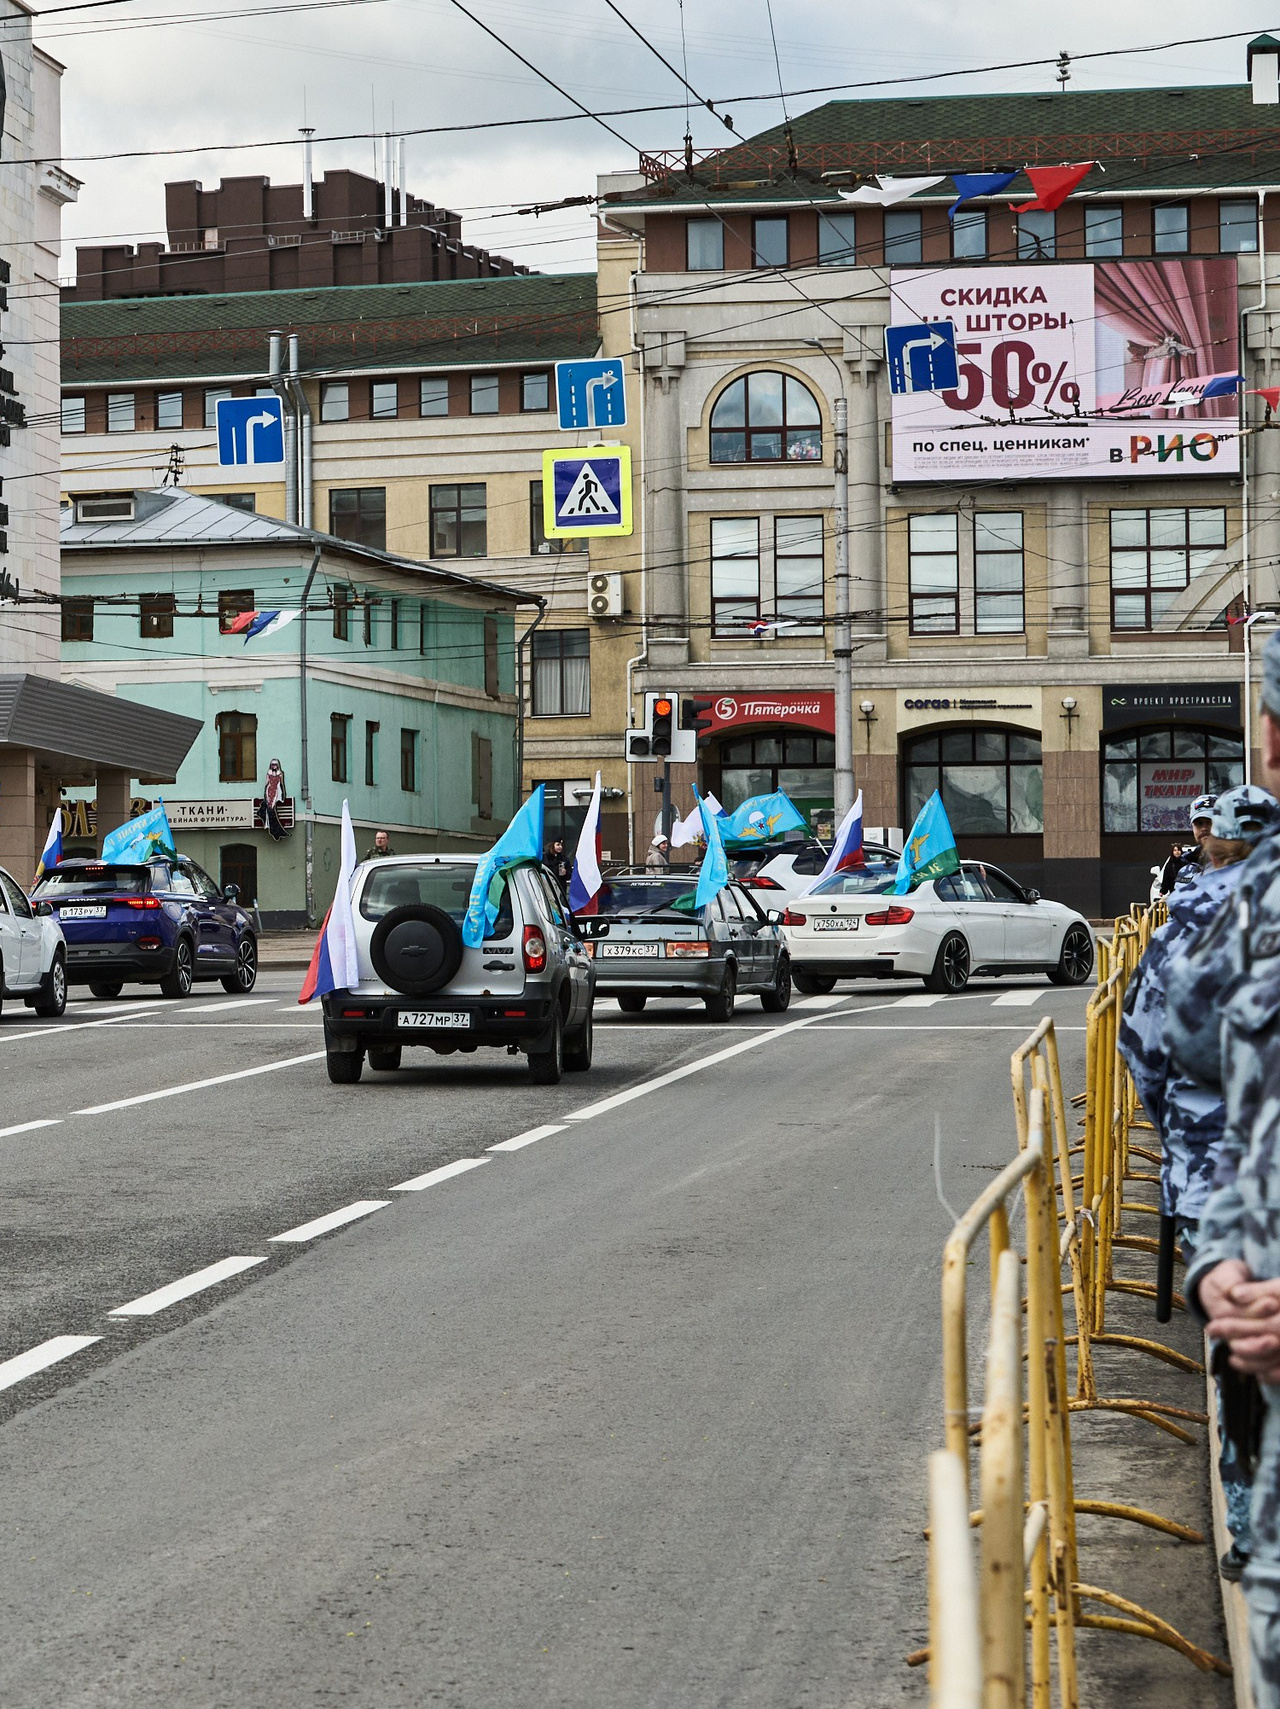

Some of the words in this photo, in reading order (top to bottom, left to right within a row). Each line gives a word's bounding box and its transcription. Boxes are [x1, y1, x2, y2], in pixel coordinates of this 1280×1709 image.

[940, 286, 1048, 308] СКИДКА
[966, 312, 1067, 332] ШТОРЫ
[941, 340, 1081, 411] 50%
[913, 441, 935, 452] по
[940, 439, 988, 453] спец.
[1130, 433, 1219, 464] РИО
[1152, 769, 1194, 782] МИР
[1144, 784, 1203, 798] ТКАНИ
[179, 806, 225, 815] ТКАНИ
[200, 816, 244, 824] ФУРНИТУРА
[453, 1013, 466, 1023] 37
